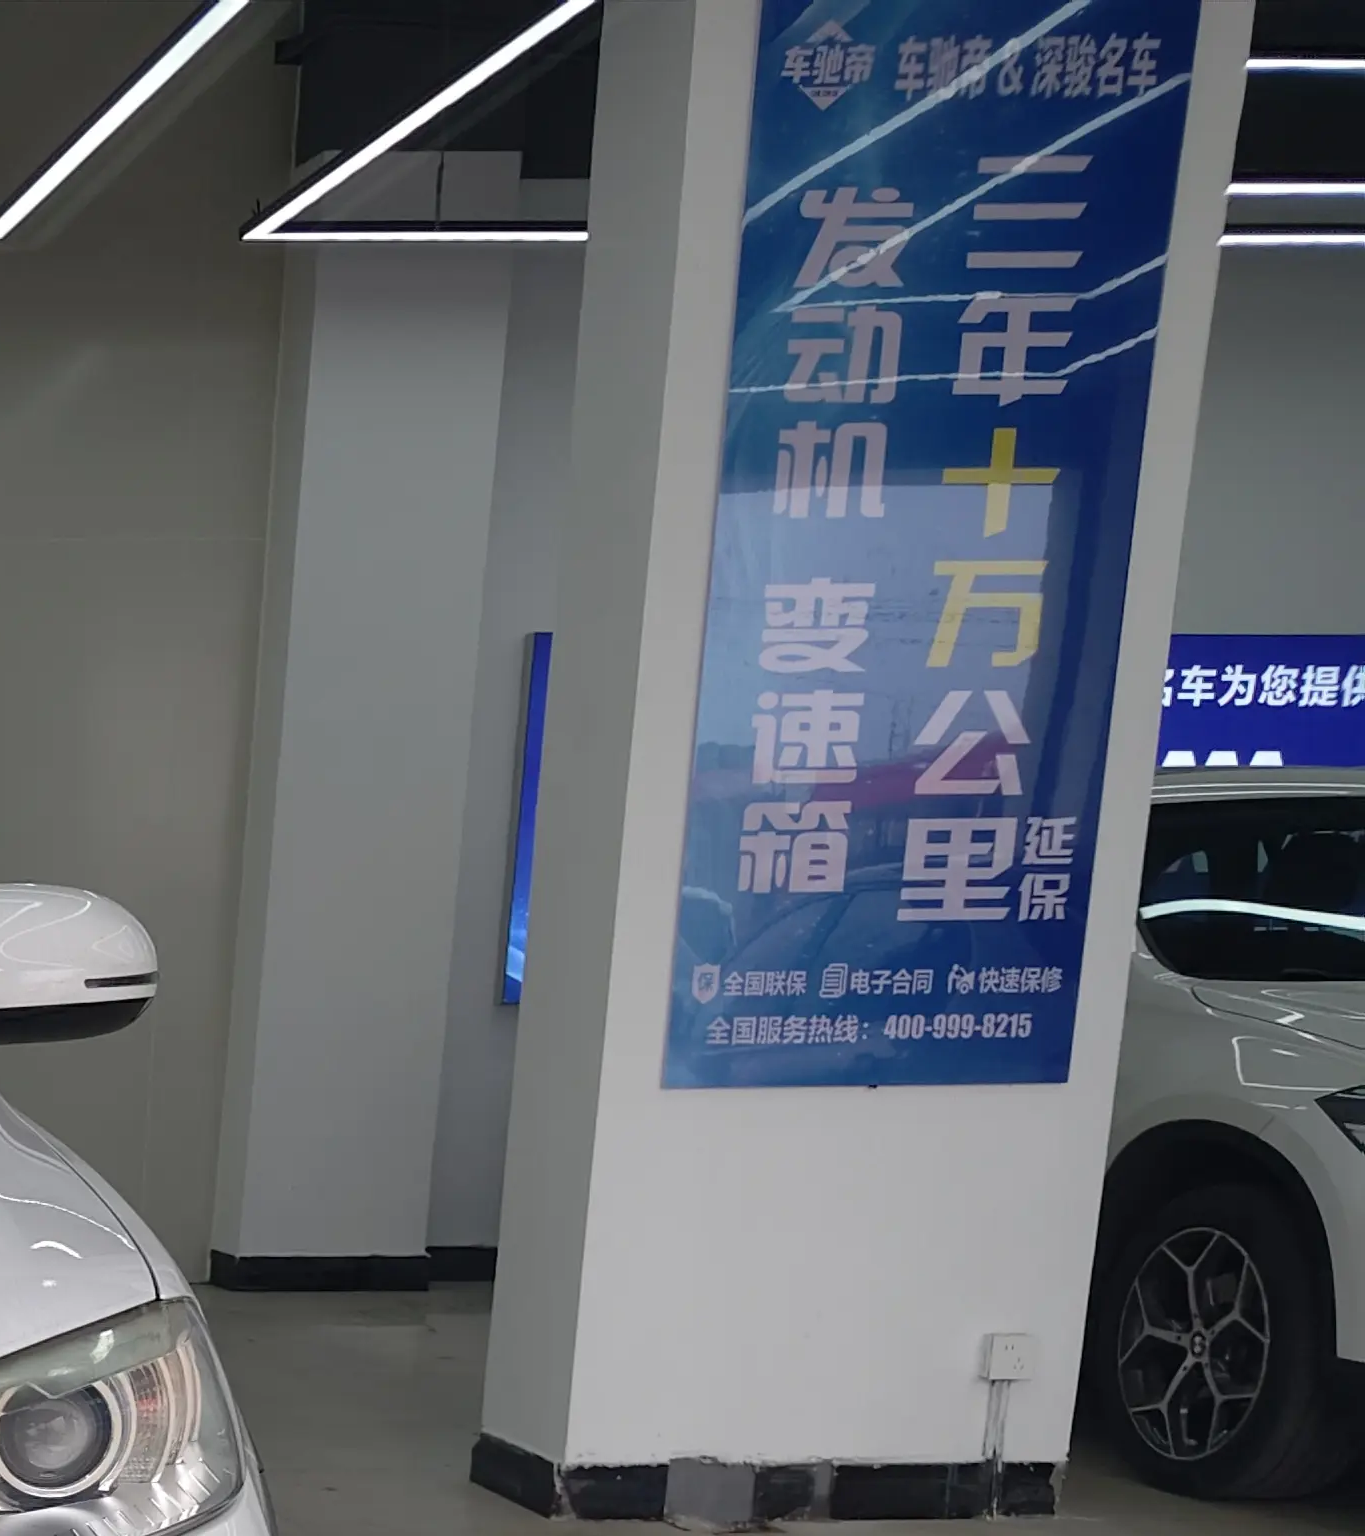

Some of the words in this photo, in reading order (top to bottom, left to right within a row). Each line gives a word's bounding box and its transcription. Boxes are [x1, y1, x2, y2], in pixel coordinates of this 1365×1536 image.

[780, 43, 877, 87] 车驰帝
[895, 35, 994, 101] 车驰帝
[1031, 32, 1163, 100] 深骏名车
[1016, 816, 1078, 924] 延保
[723, 969, 807, 996] 全国联保
[850, 968, 934, 995] 电子合同
[979, 966, 1064, 994] 快速保修
